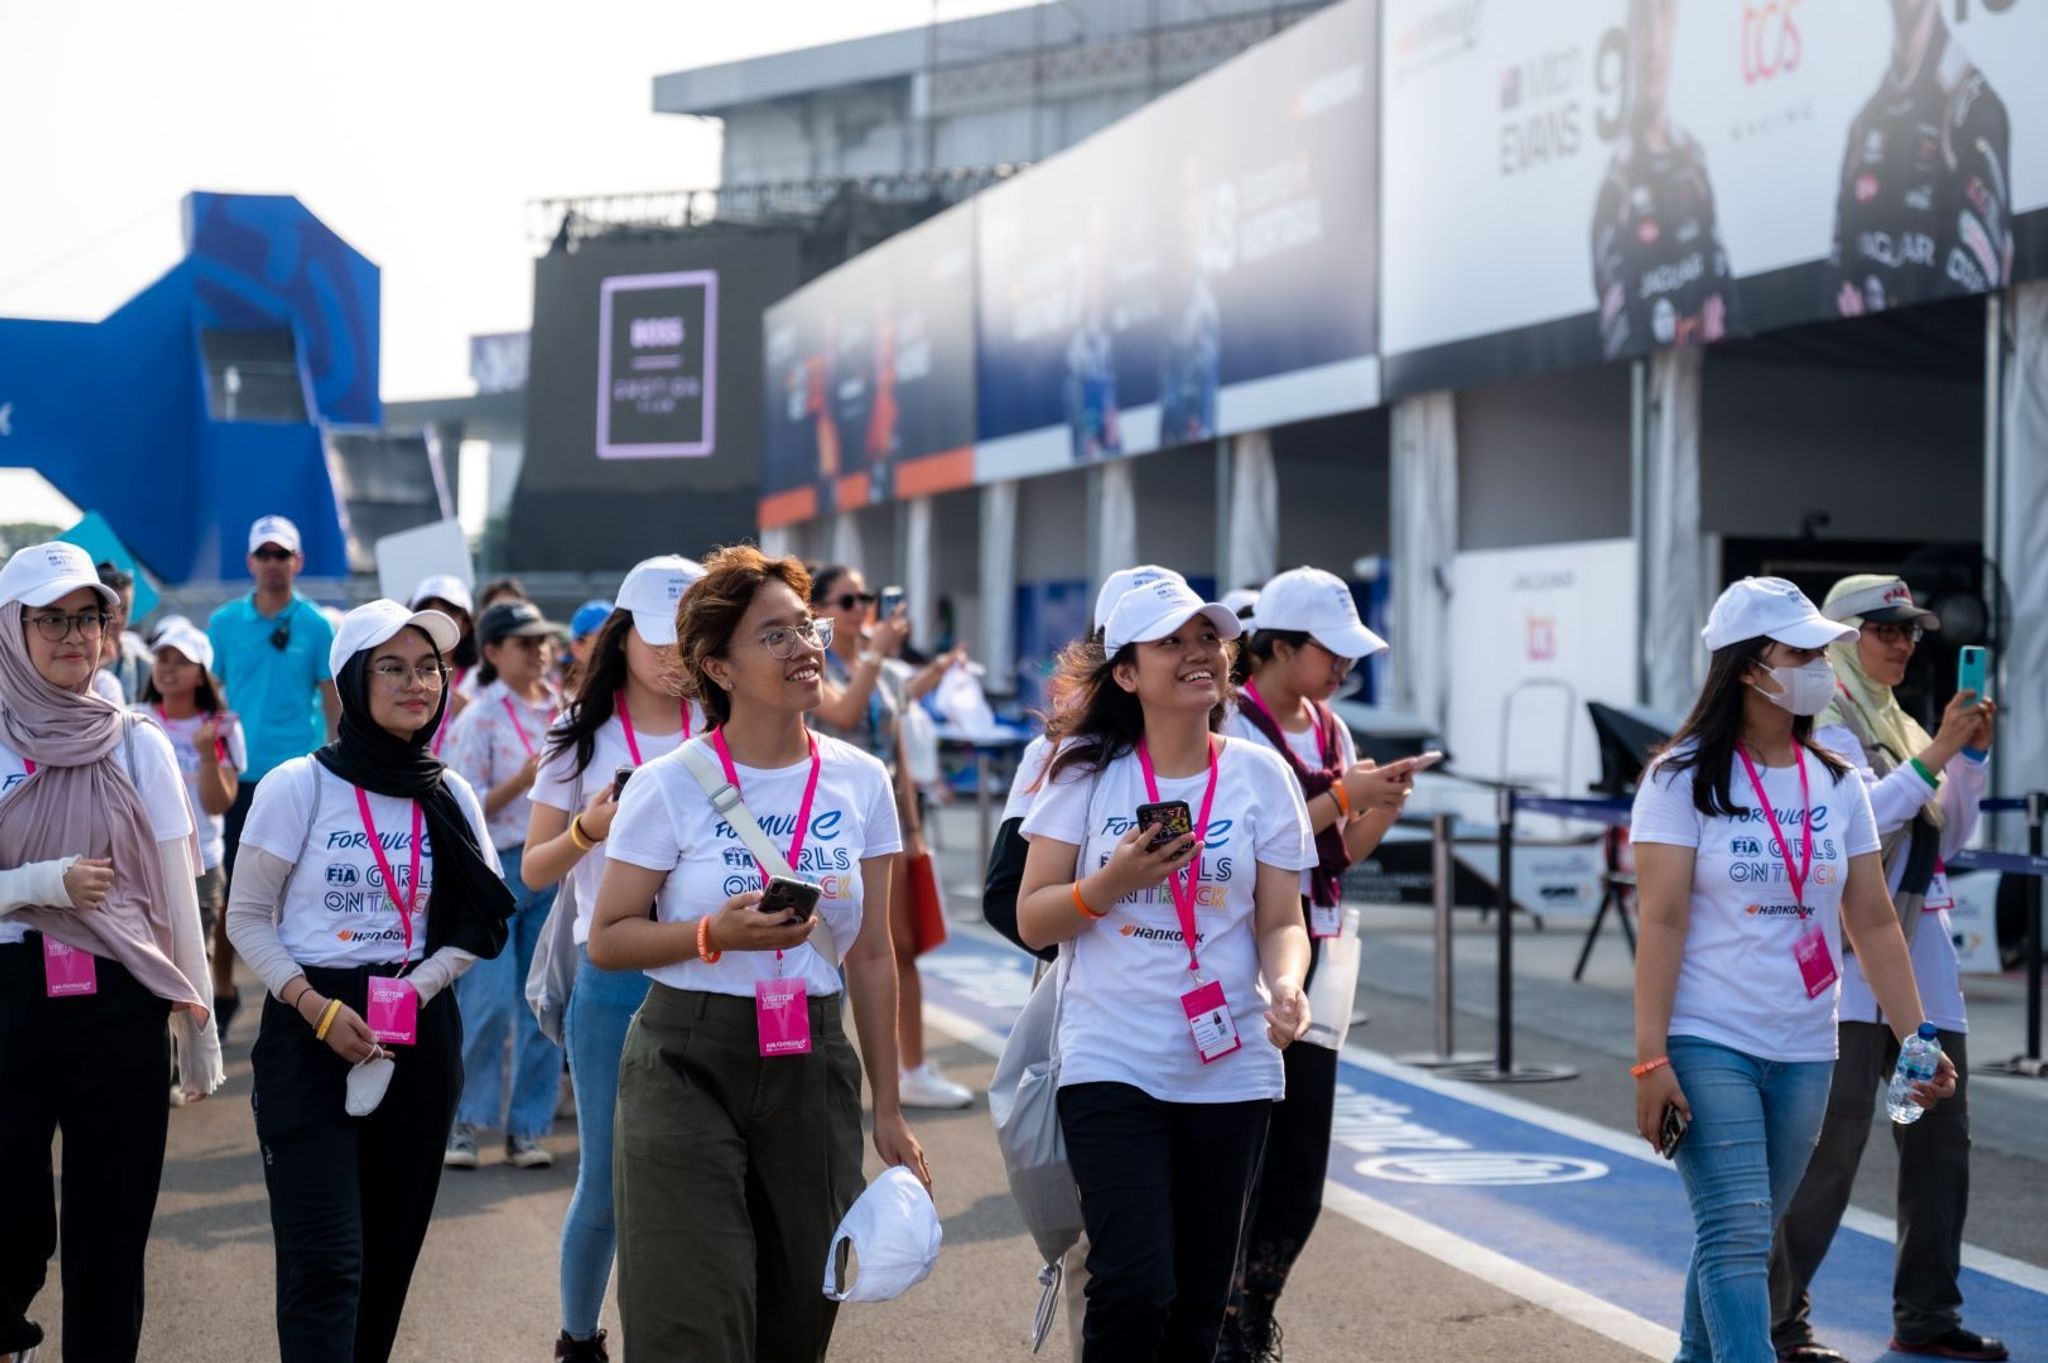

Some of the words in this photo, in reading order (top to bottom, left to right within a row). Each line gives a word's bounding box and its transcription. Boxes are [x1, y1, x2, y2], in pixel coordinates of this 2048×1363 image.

[1594, 30, 1629, 142] 9
[1500, 102, 1581, 176] EVANS
[1729, 862, 1768, 882] ON
[324, 891, 364, 913] ON
[1141, 885, 1231, 909] TRCK
